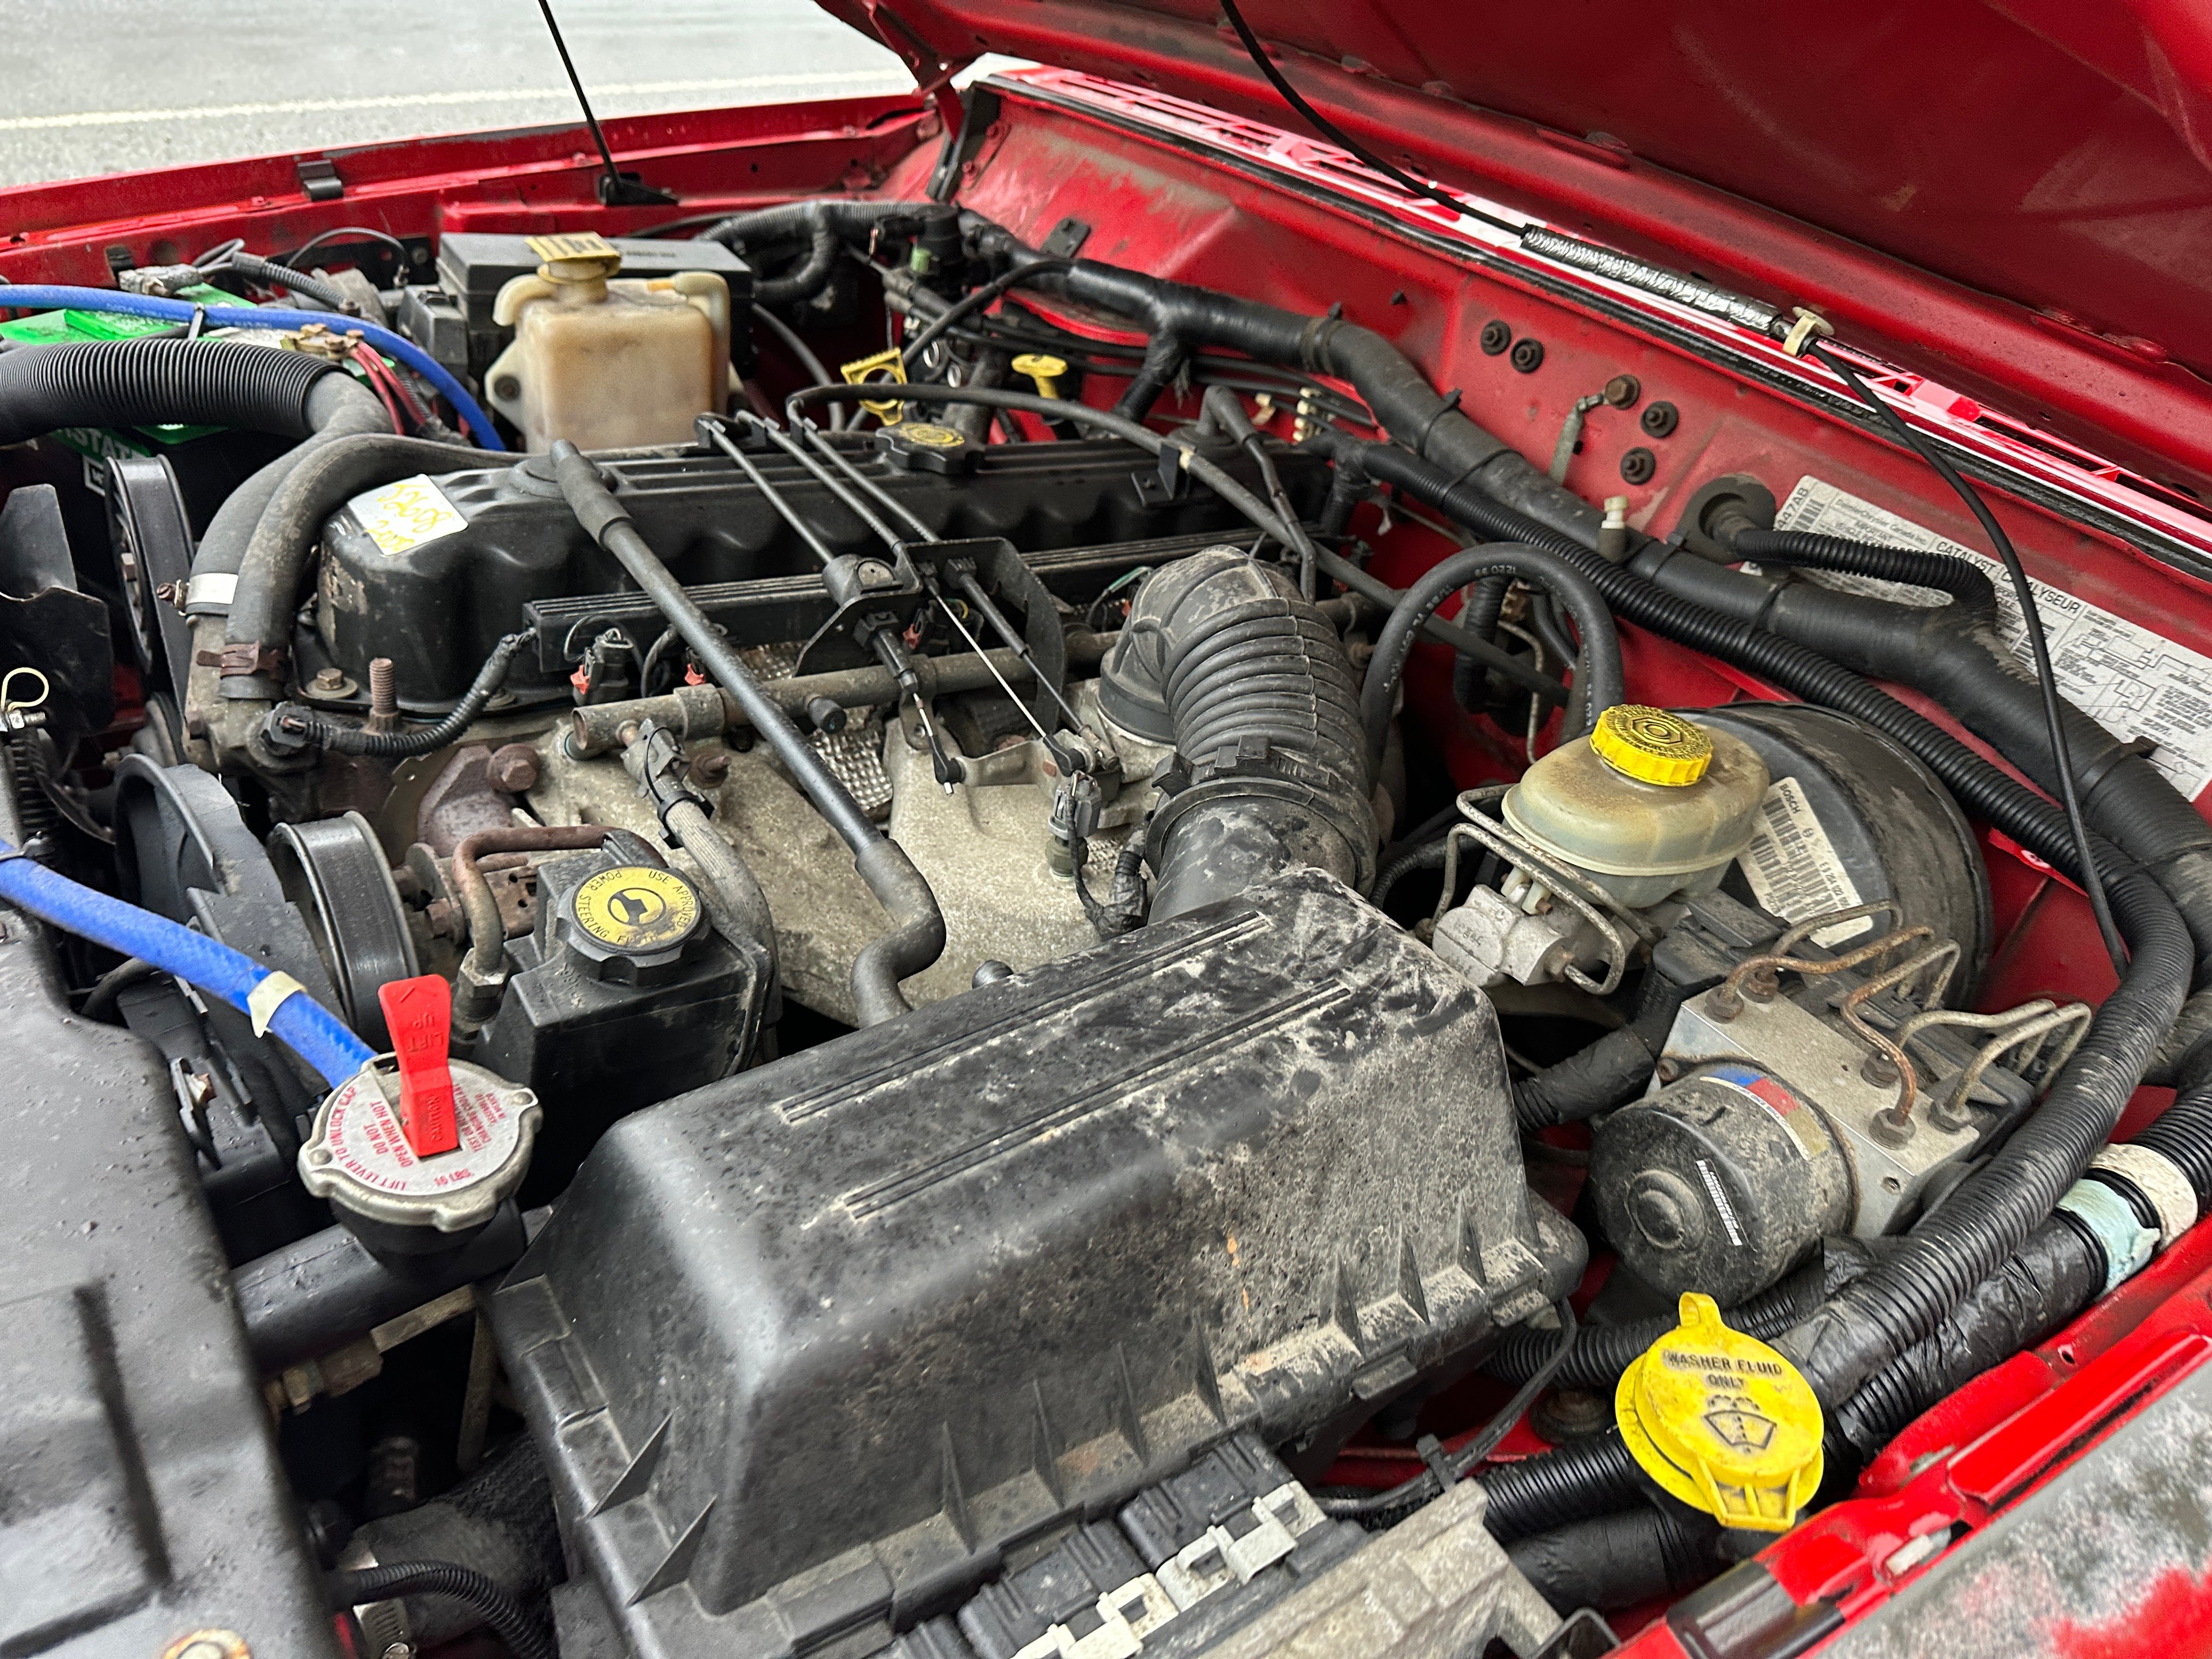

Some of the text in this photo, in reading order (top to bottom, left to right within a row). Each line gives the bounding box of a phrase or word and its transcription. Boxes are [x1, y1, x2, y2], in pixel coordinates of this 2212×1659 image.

[1936, 541, 1997, 574] CATALYST
[2001, 570, 2081, 614] CALYSEUR
[1778, 783, 1801, 815] BOSCH
[577, 870, 623, 938] POWER STEERING
[648, 870, 695, 929] USE APPROVED
[412, 1012, 435, 1030] UP
[408, 1031, 445, 1052] LIFT
[329, 1086, 407, 1191] LIFT LEVER TO UNLOCK CAP
[363, 1123, 389, 1155] DO NOT
[370, 1100, 414, 1168] OPEN WHEN HOT
[1664, 1351, 1783, 1376] WASHER FLUID
[1706, 1373, 1746, 1389] ONLY
